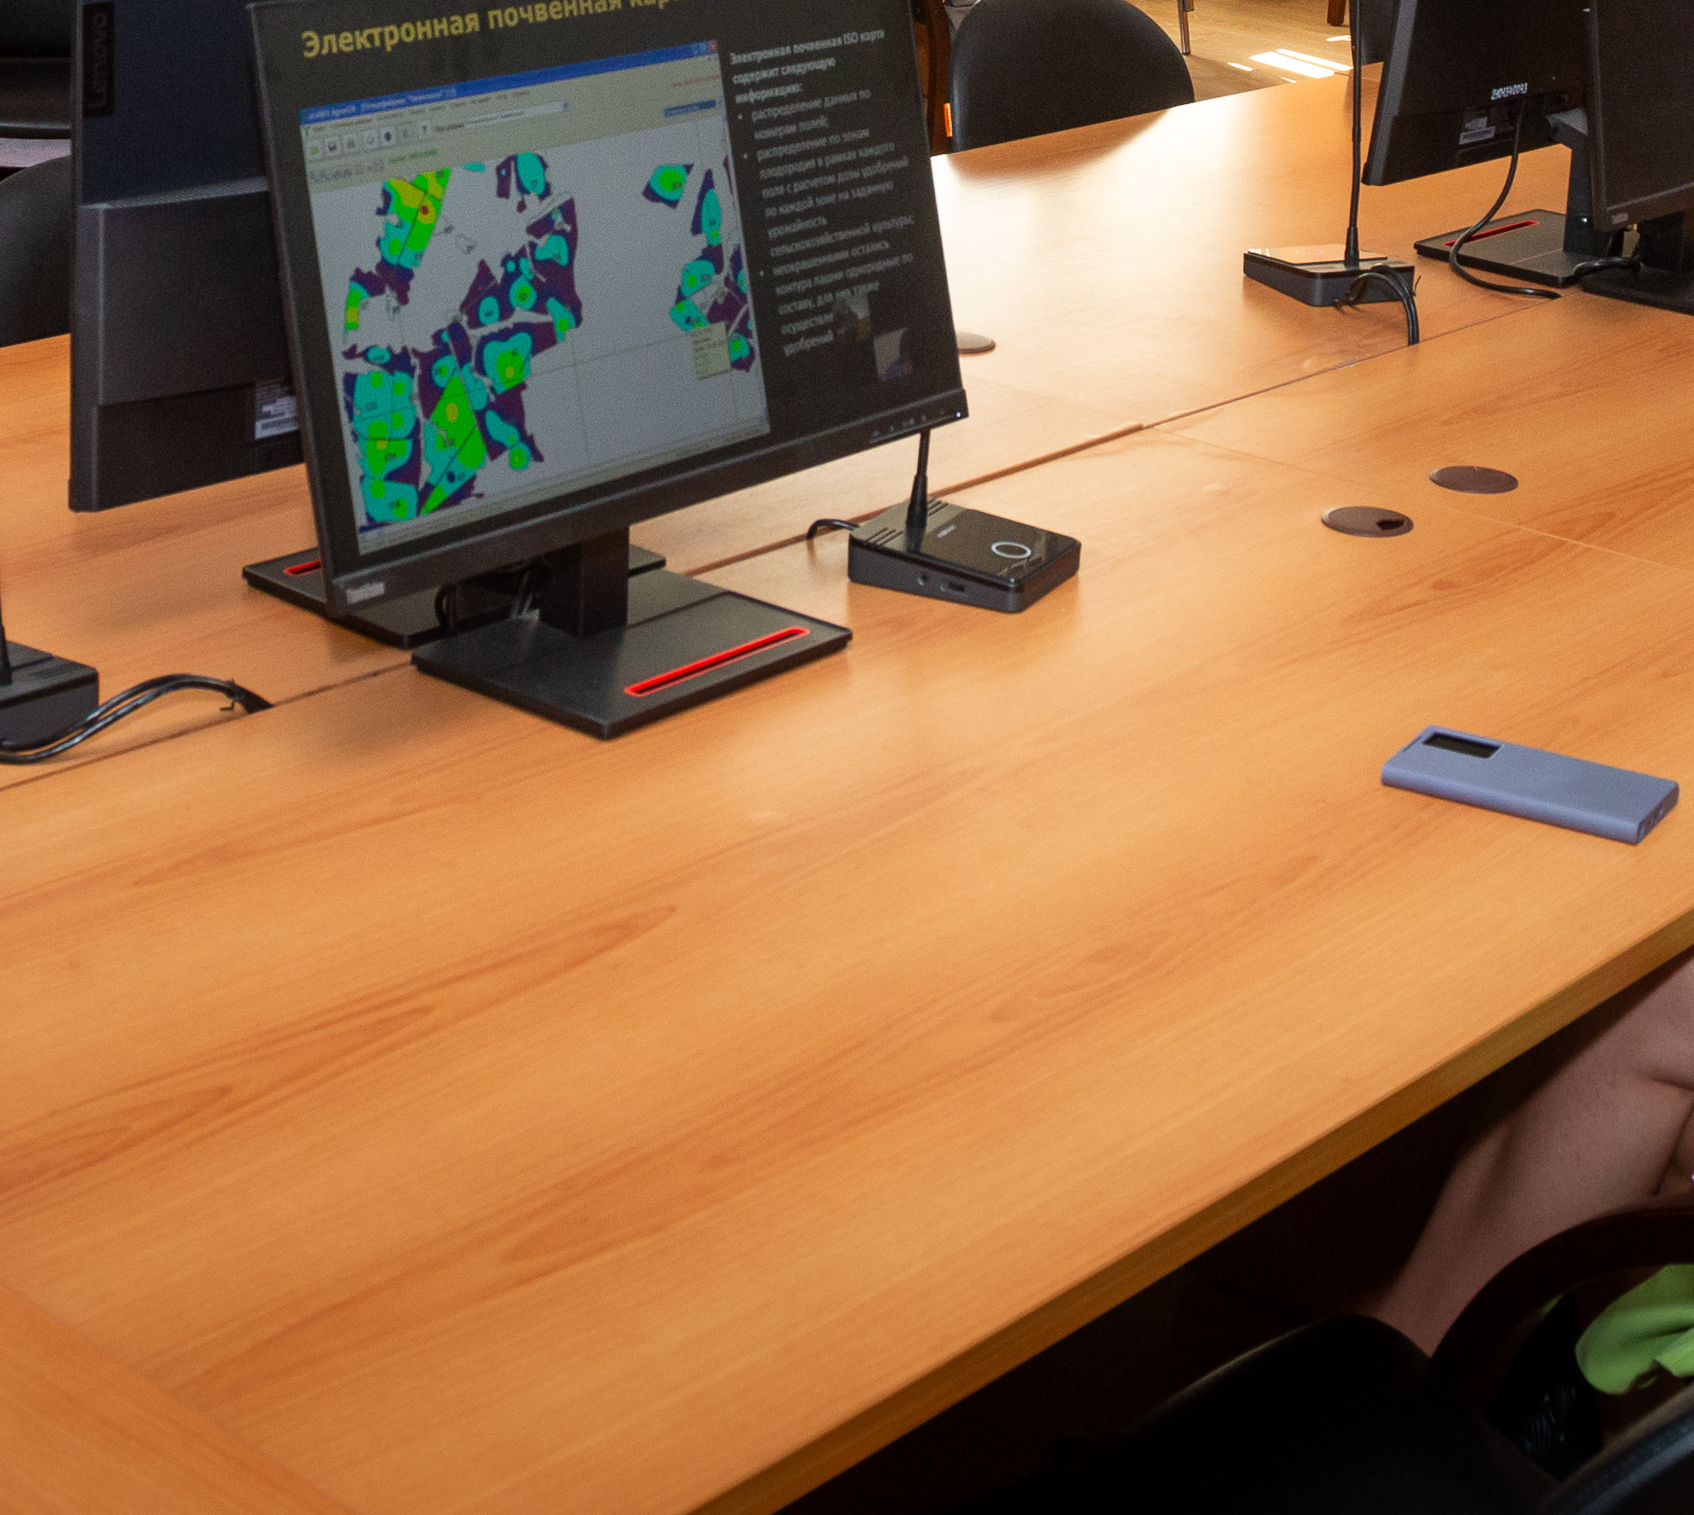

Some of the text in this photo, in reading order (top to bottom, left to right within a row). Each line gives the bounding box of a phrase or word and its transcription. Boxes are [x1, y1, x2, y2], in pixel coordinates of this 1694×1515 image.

[301, 11, 480, 58] Электронная
[729, 45, 792, 66] Электронная
[793, 38, 843, 55] почвенная
[859, 28, 886, 44] карта
[732, 57, 837, 86] содержит следующую
